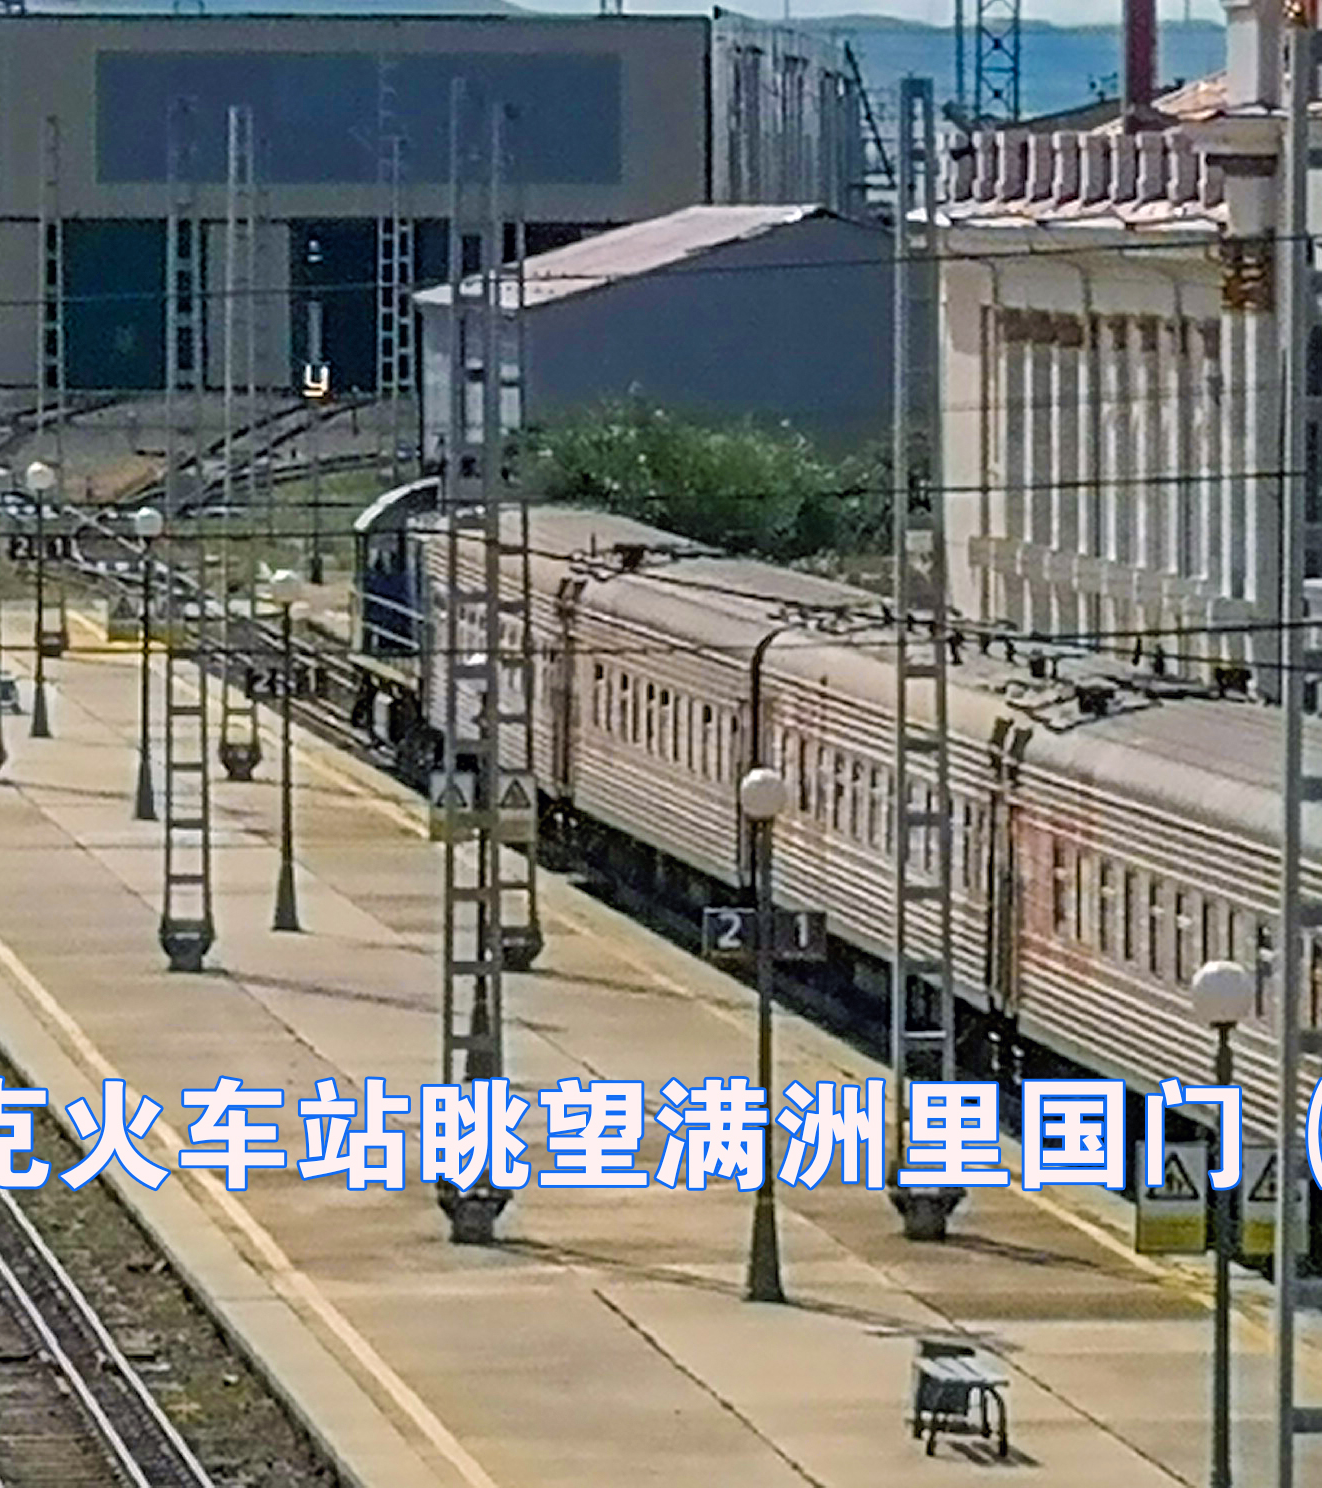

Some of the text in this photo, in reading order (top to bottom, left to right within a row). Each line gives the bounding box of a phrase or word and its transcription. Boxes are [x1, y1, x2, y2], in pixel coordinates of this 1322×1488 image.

[15, 536, 29, 558] 2
[252, 669, 271, 693] 2
[717, 912, 742, 949] 2
[795, 912, 808, 948] 1
